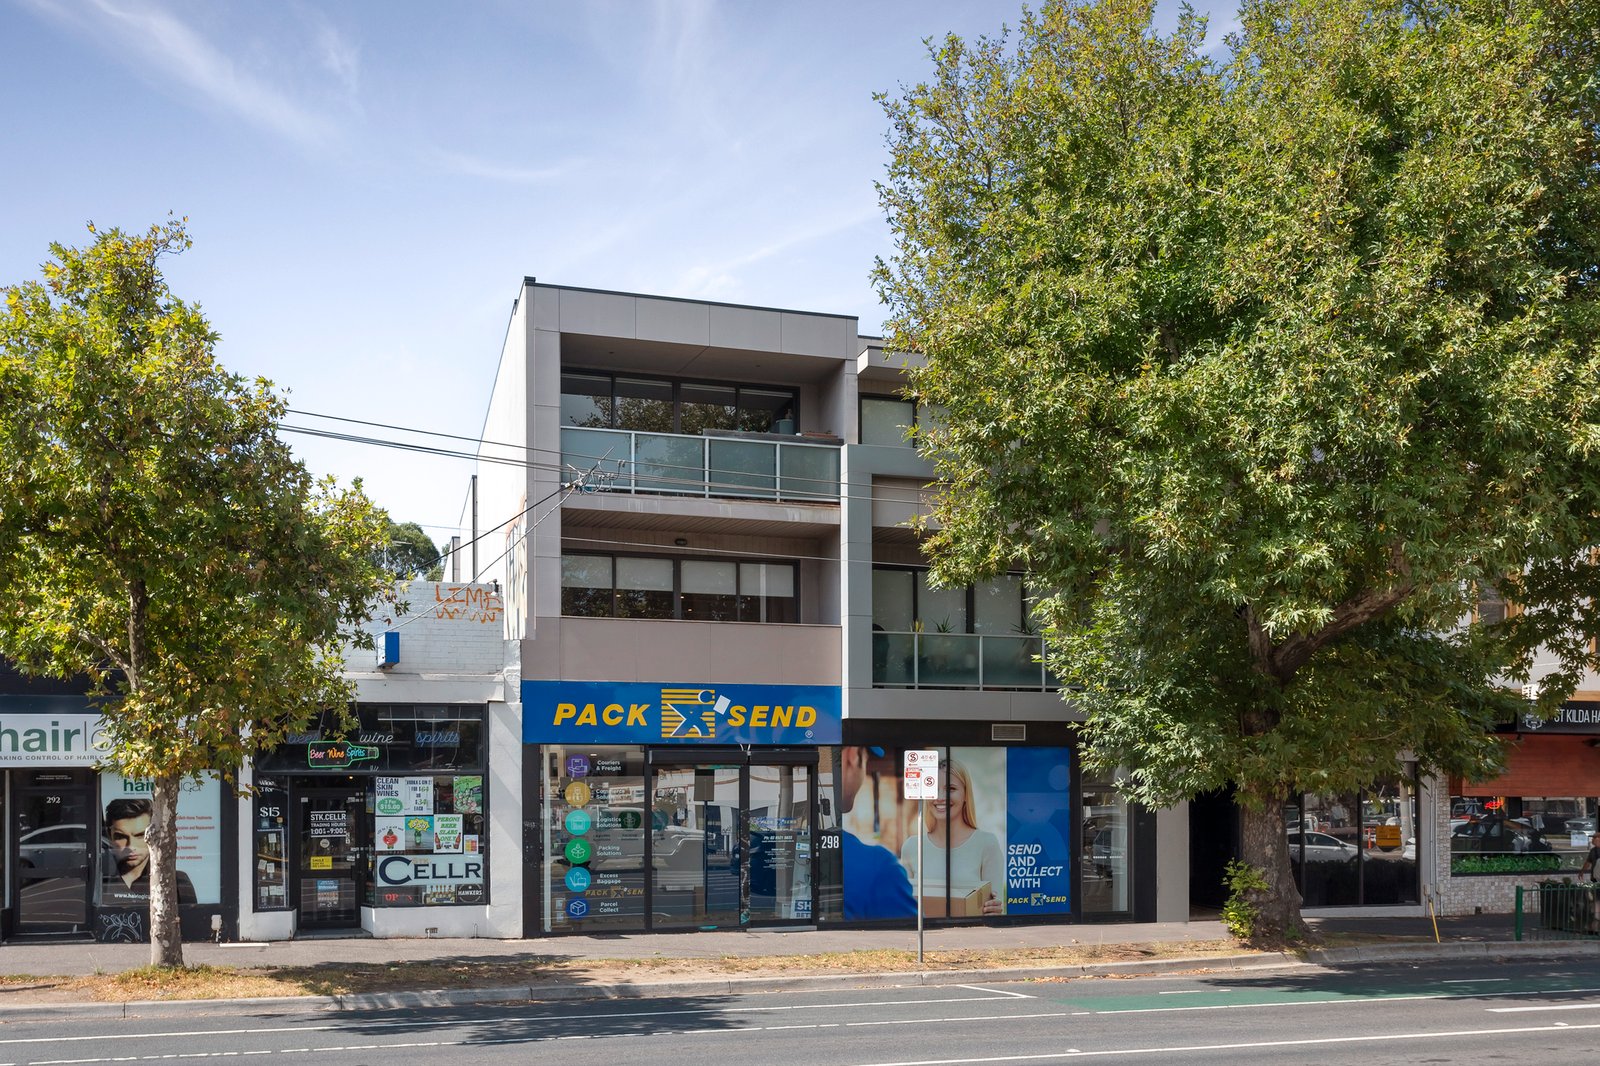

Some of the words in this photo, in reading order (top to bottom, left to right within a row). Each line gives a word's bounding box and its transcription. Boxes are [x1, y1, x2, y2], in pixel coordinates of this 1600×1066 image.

[553, 703, 651, 727] PACK
[727, 705, 817, 728] SEND
[1566, 709, 1590, 723] KILDA
[360, 731, 394, 744] wine
[416, 731, 460, 745] spirits
[310, 749, 325, 760] Beer
[327, 748, 345, 758] Wine
[46, 796, 61, 804] 292
[259, 806, 280, 818] $15
[310, 813, 347, 821] STK.CELLR
[821, 835, 840, 849] 298
[1008, 844, 1042, 855] SEND
[1008, 856, 1036, 867] AND
[1009, 866, 1063, 877] COLLECT
[1009, 878, 1041, 888] WITH
